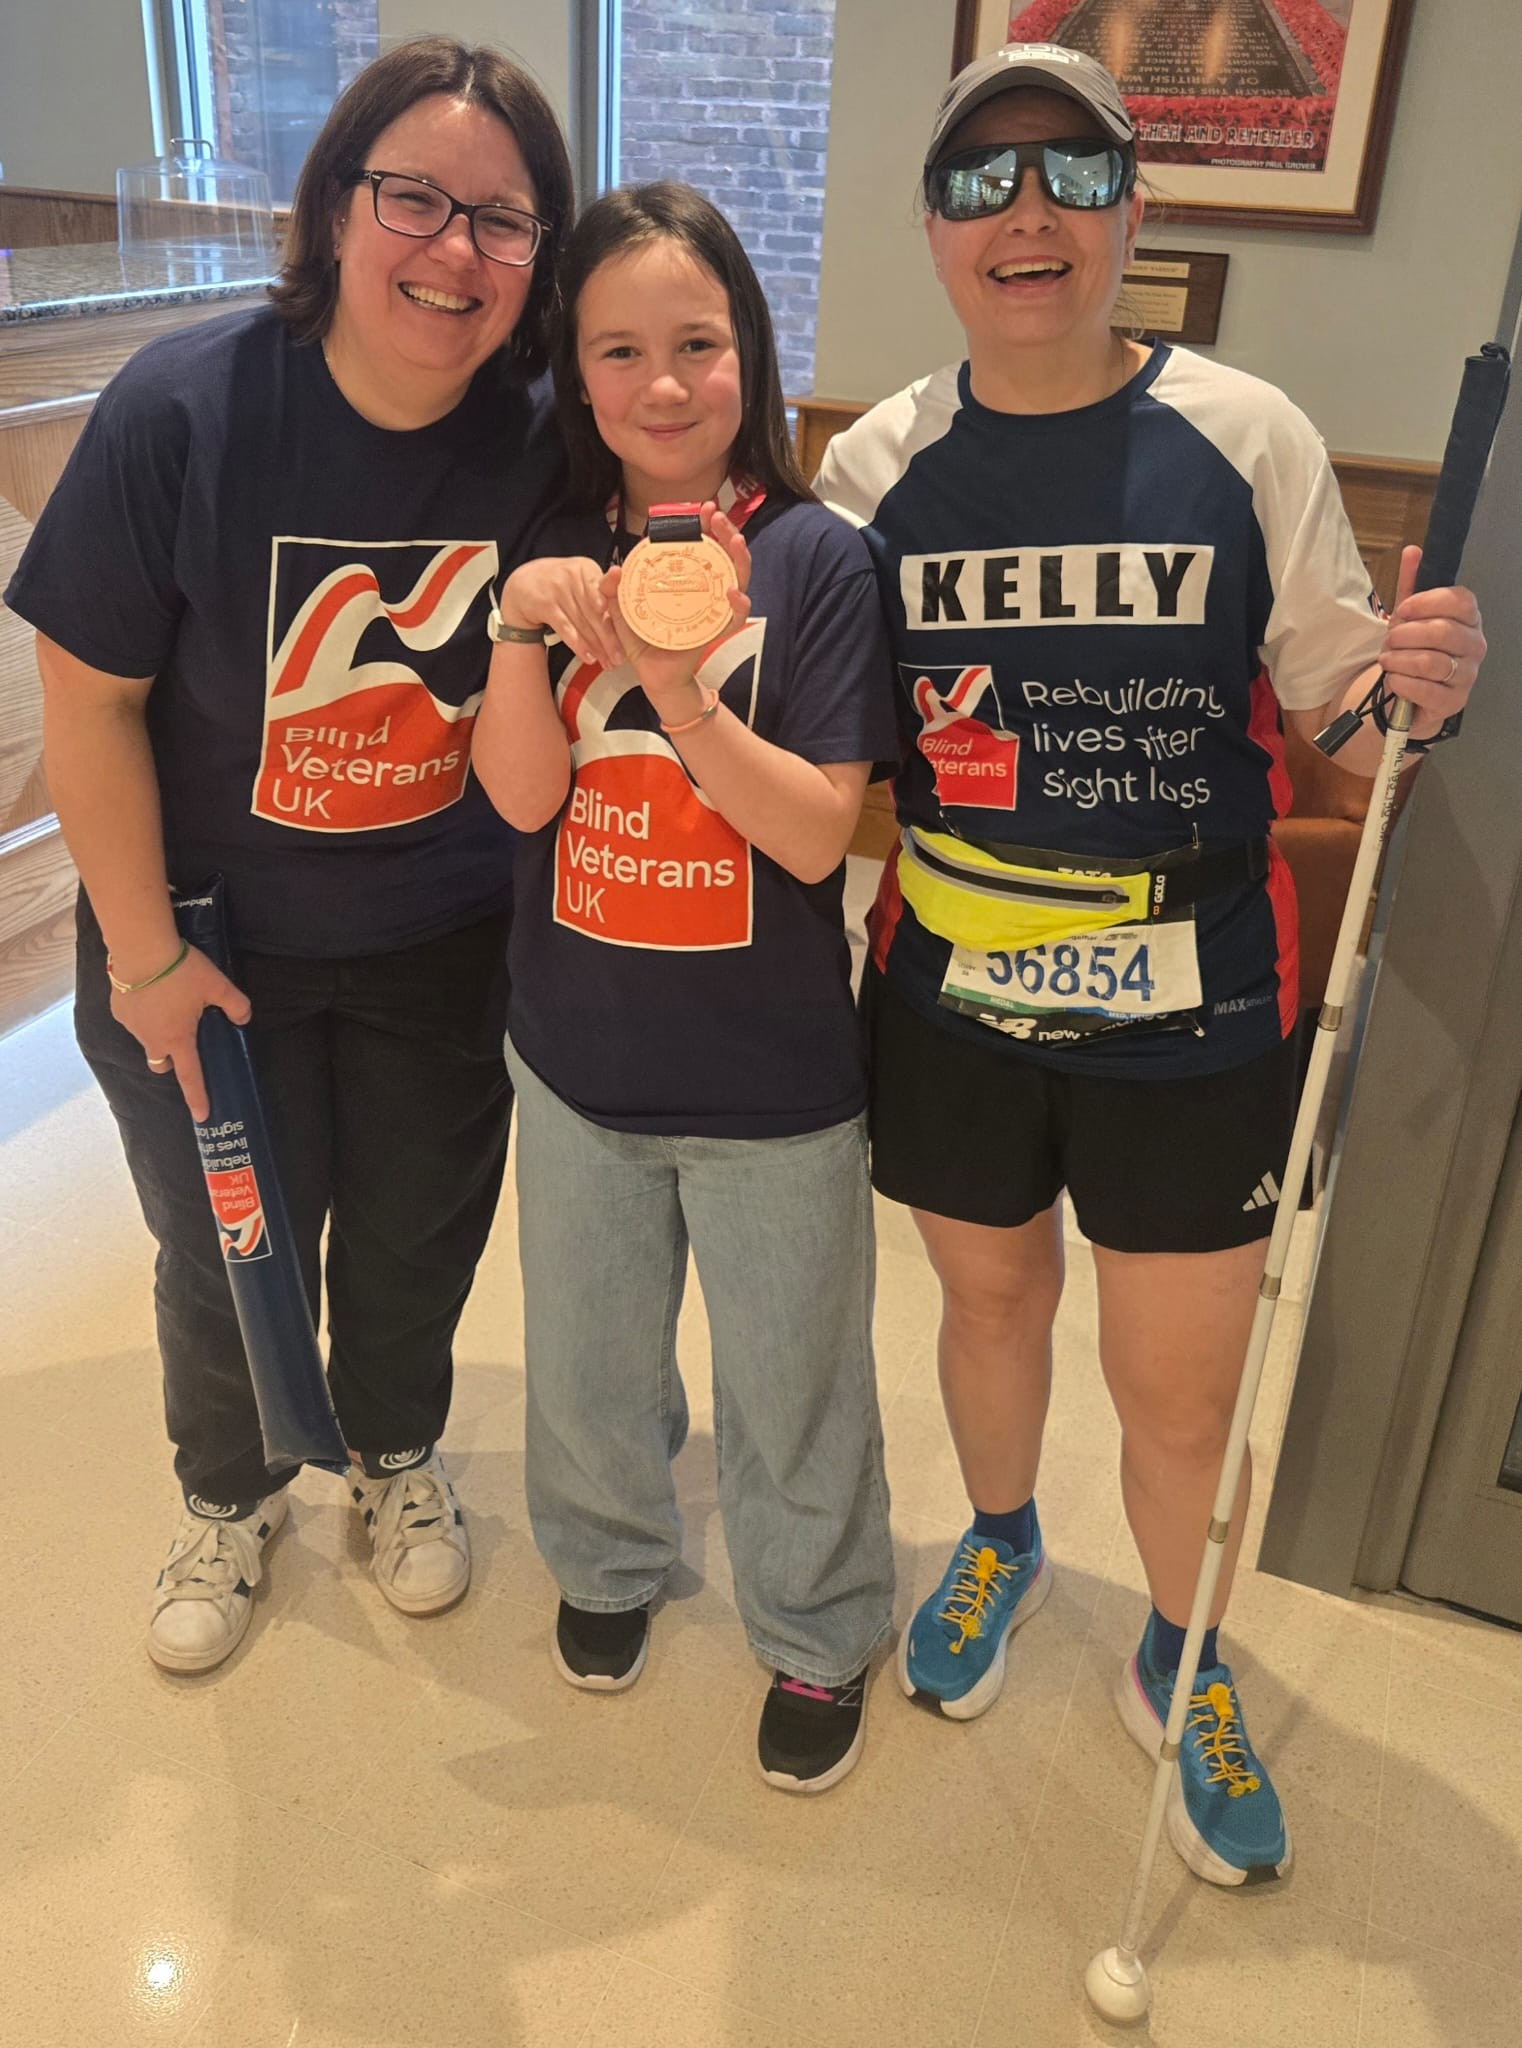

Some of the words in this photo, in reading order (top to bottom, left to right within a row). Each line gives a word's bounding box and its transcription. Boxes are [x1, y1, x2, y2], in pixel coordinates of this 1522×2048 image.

[1184, 125, 1224, 144] AND
[1225, 126, 1317, 149] REMEMBER
[1211, 158, 1265, 168] PHOTOGRAPHY
[921, 552, 1197, 622] KELLY
[285, 715, 391, 750] Blind
[1033, 723, 1126, 753] lives
[923, 737, 974, 756] Blind
[280, 744, 460, 787] Veterans
[272, 778, 333, 820] UK
[1043, 768, 1138, 809] sight
[1150, 766, 1211, 808] loss
[569, 785, 650, 840] Blind
[566, 830, 736, 889] Veterans
[566, 875, 607, 924] UK
[1214, 998, 1247, 1016] MAX
[1038, 1029, 1081, 1042] new
[209, 1121, 244, 1139] sight
[216, 1136, 249, 1152] lives
[229, 1173, 249, 1186] UK
[223, 1197, 255, 1212] Blind
